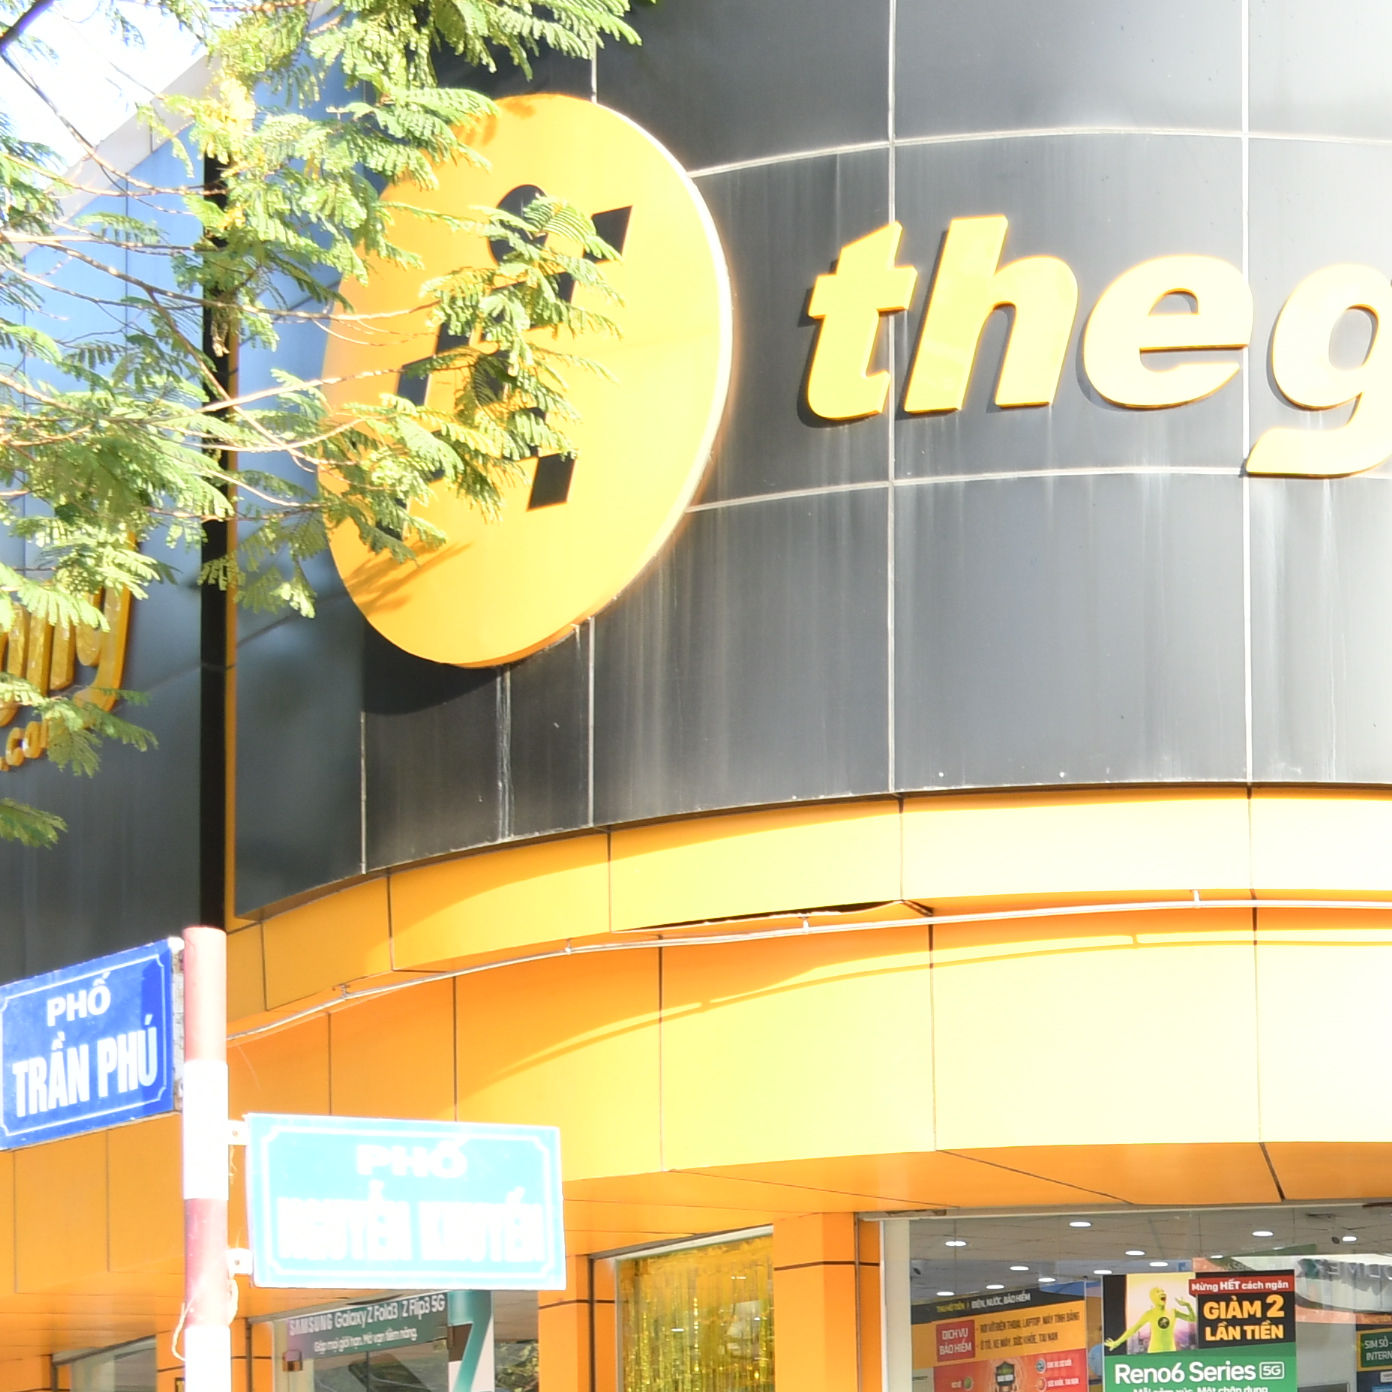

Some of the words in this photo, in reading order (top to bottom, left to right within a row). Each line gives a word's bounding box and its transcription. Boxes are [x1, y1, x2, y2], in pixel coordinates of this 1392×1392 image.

[47, 971, 112, 1027] PHỐ
[12, 1031, 91, 1118] TRẦN
[97, 1013, 158, 1099] PHÚ
[356, 1134, 469, 1178] PHỐ
[1191, 1281, 1219, 1293] Mừng
[1219, 1278, 1240, 1291] HẾT
[1241, 1279, 1265, 1291] cách
[1265, 1279, 1289, 1292] ngăn
[288, 1313, 333, 1337] SAMSUNG
[334, 1309, 366, 1329] Galaxy
[374, 1302, 400, 1321] Fold3
[409, 1296, 431, 1321] Flip3
[431, 1294, 446, 1313] 5G
[1203, 1295, 1262, 1320] GIẢM
[1265, 1294, 1285, 1318] 2
[1205, 1320, 1241, 1341] LẦN
[1243, 1320, 1284, 1340] TIỀN
[1114, 1362, 1185, 1385] Reno6
[1189, 1360, 1257, 1383] Series
[1262, 1365, 1282, 1377] 5G
